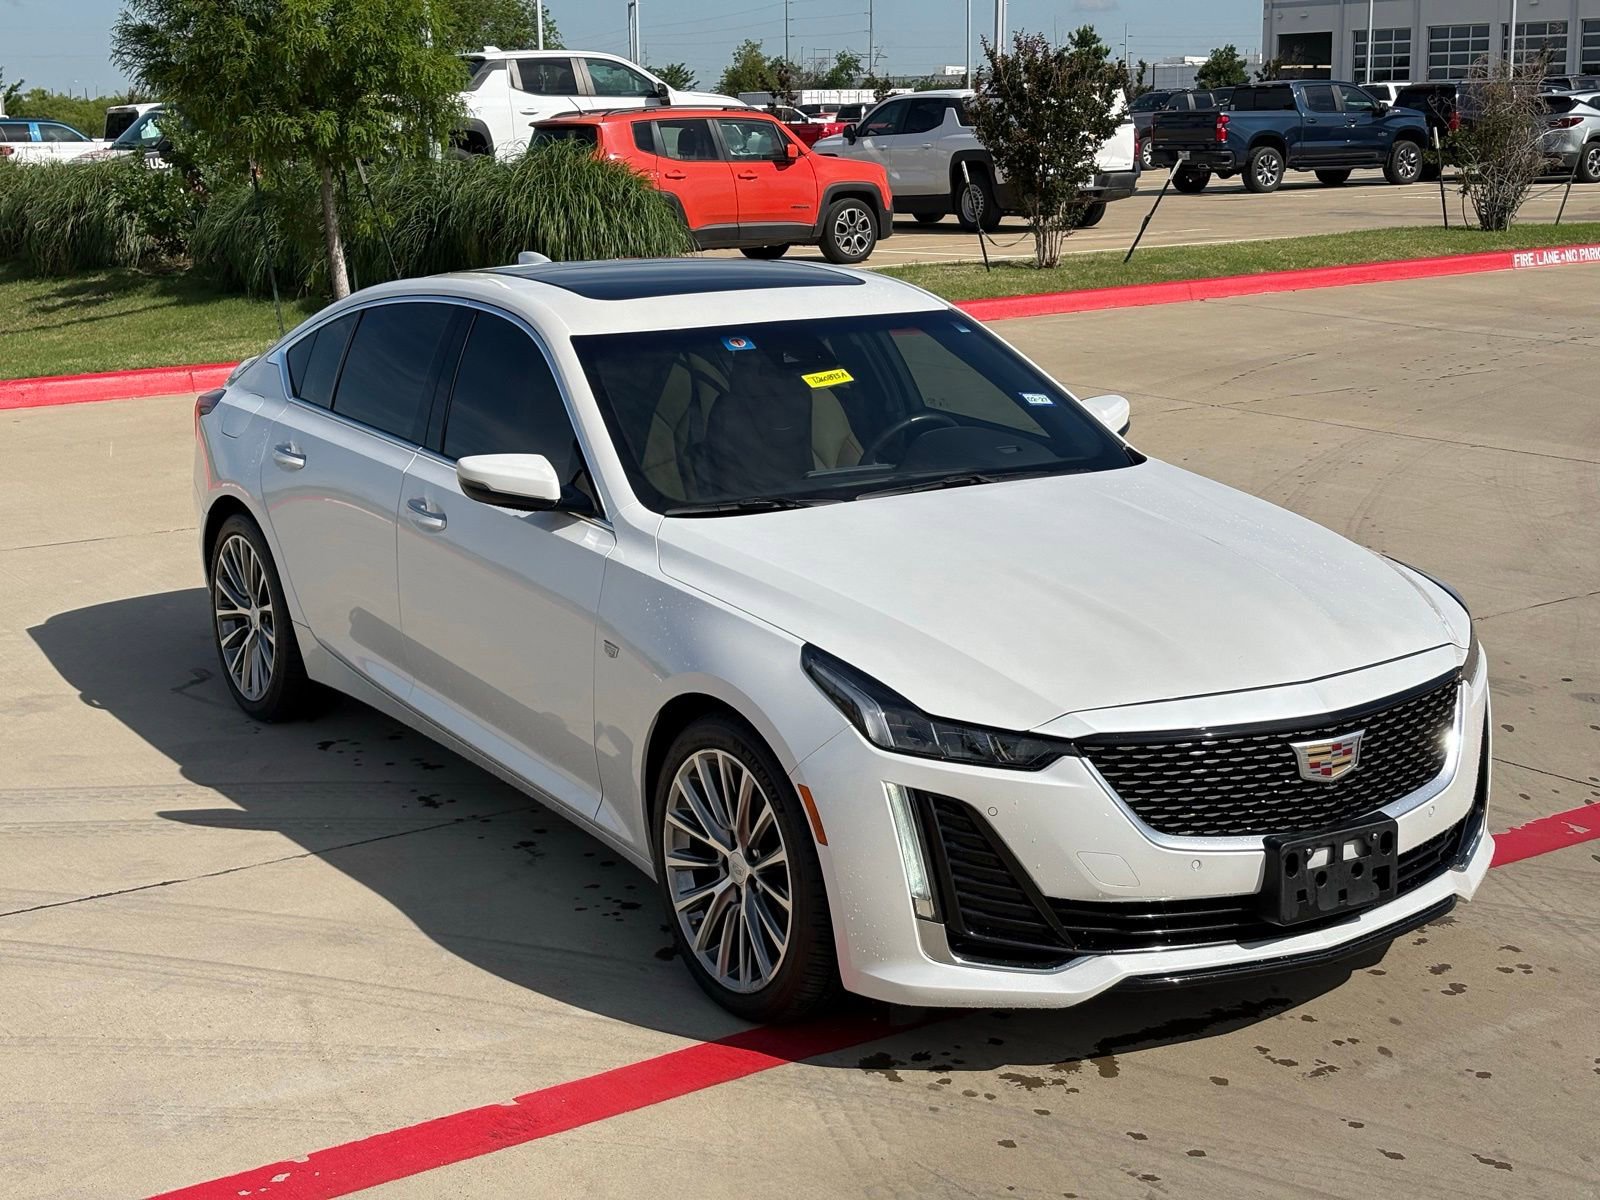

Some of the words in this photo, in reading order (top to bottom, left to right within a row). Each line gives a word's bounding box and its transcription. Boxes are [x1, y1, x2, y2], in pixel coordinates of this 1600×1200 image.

[1514, 253, 1535, 267] FIRE
[1537, 251, 1561, 265] LANE
[1565, 249, 1577, 262] NO
